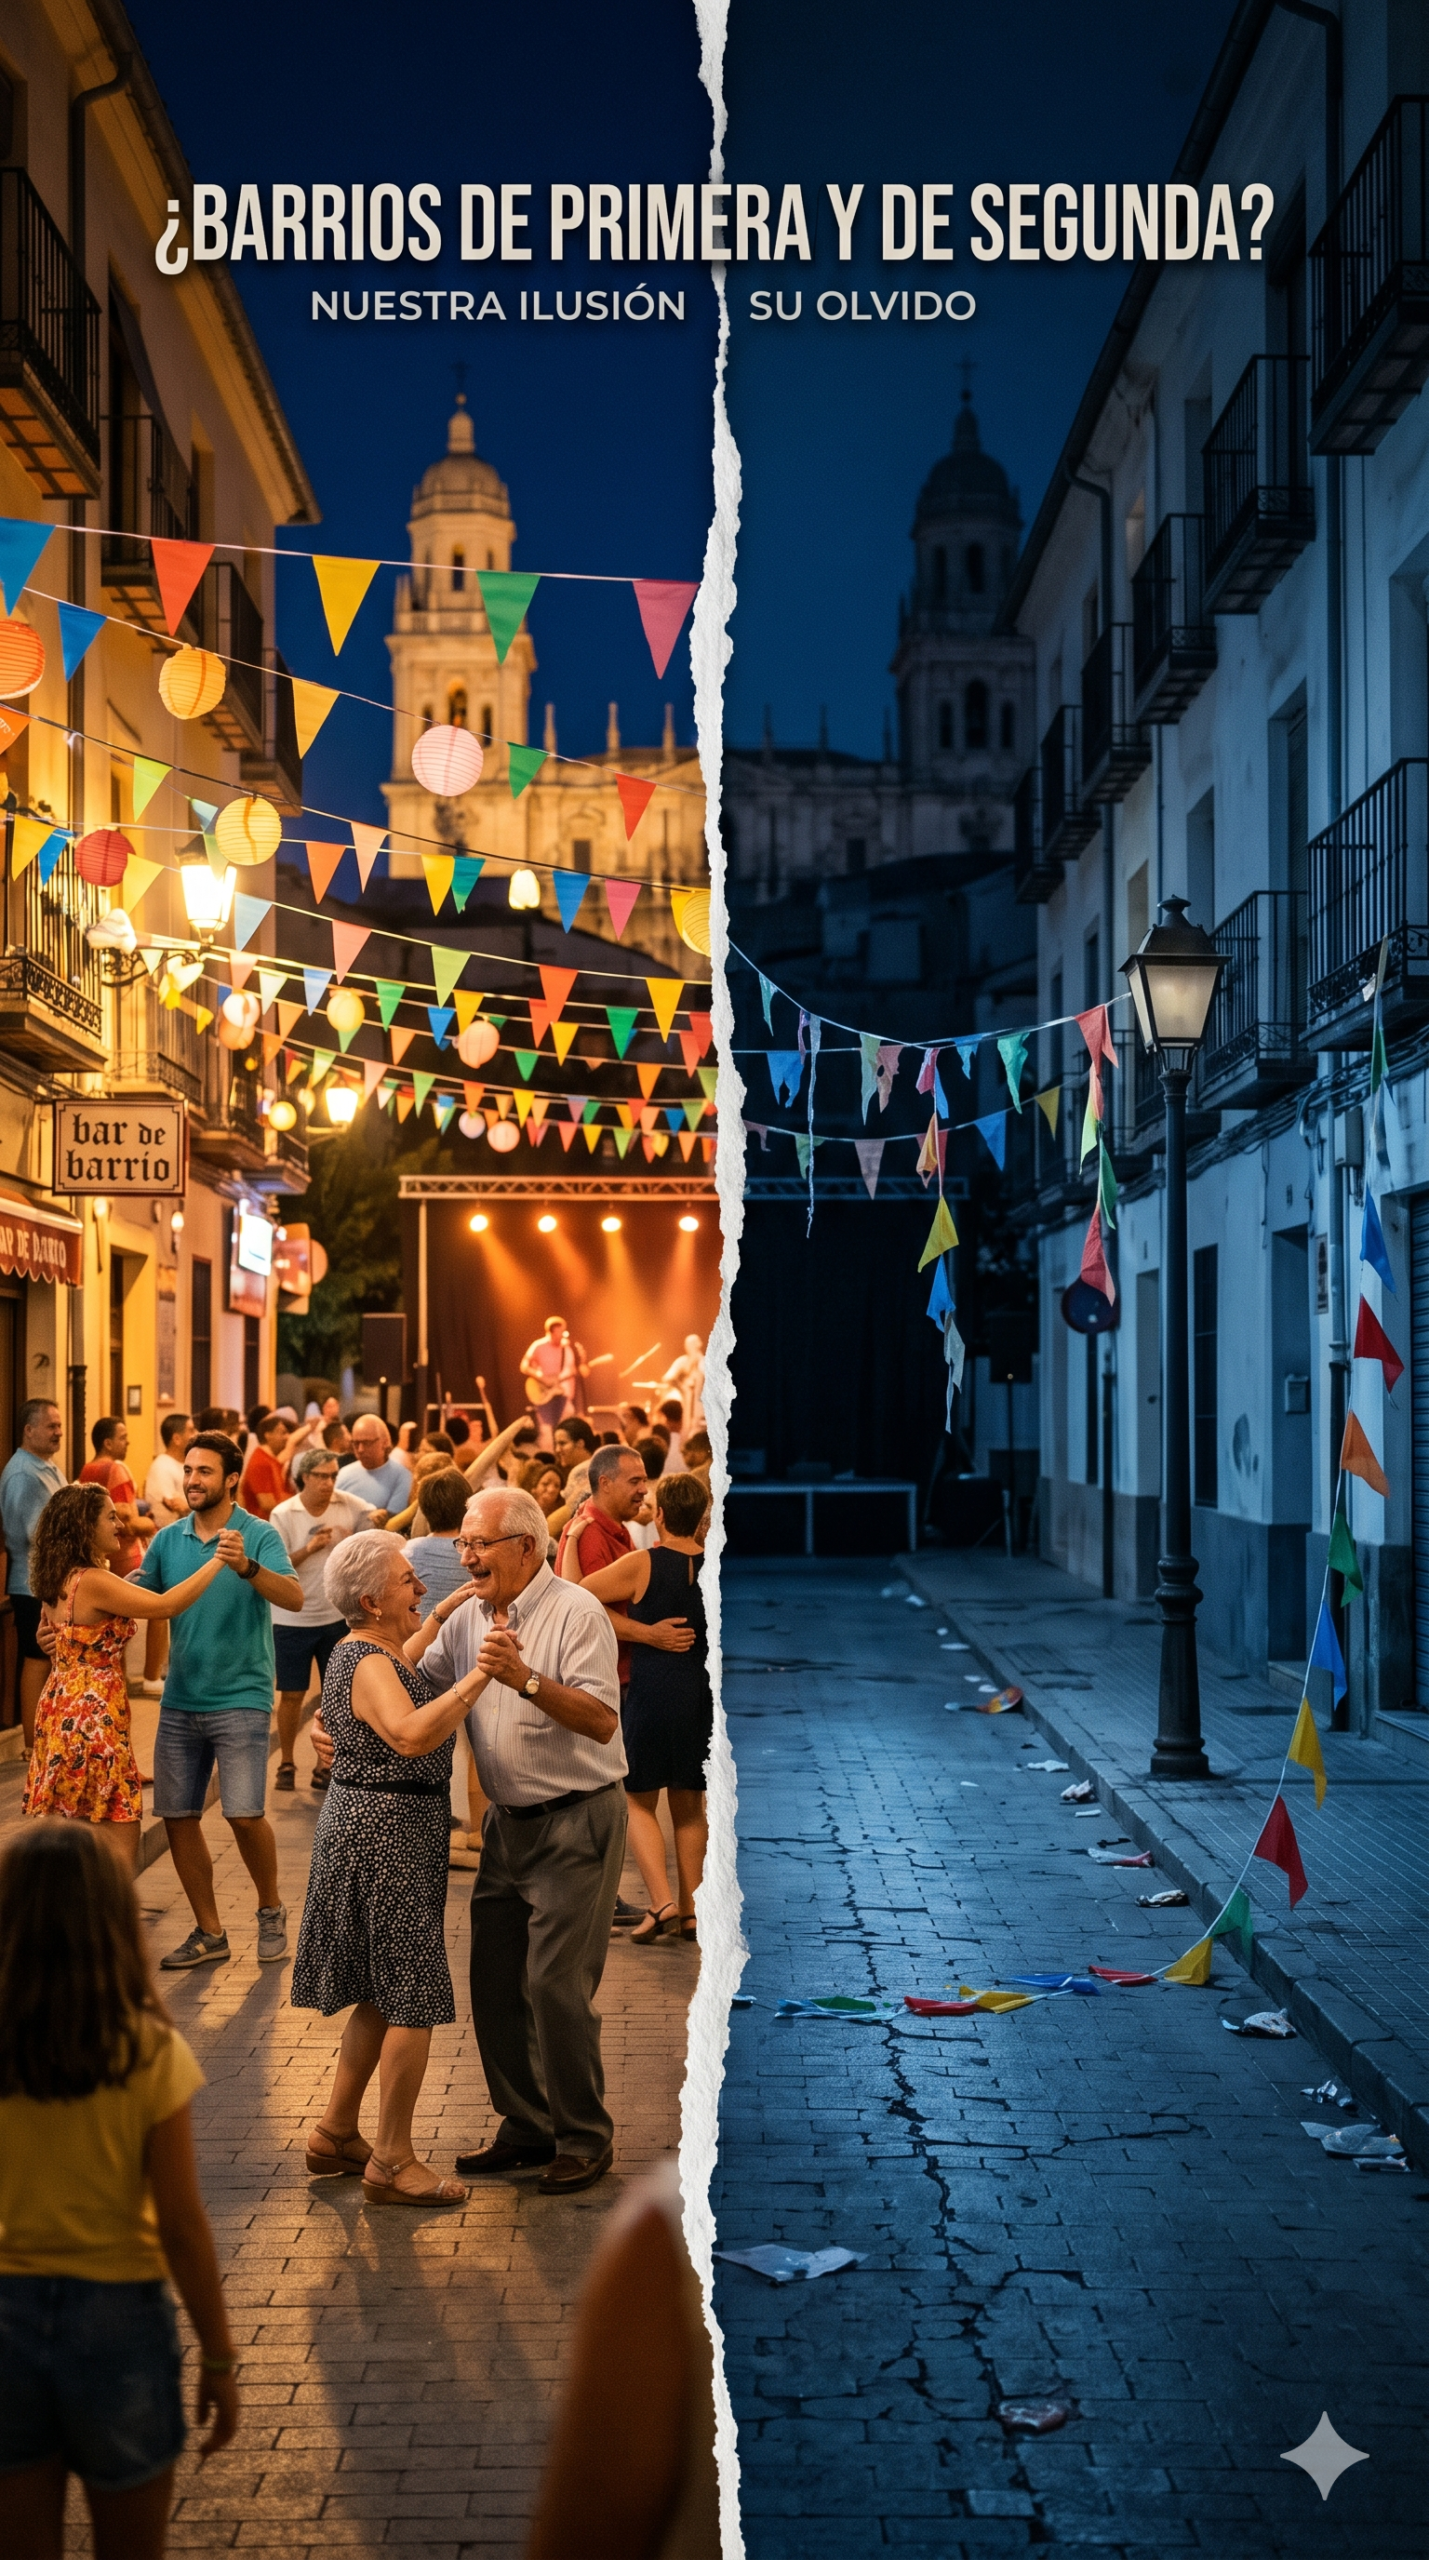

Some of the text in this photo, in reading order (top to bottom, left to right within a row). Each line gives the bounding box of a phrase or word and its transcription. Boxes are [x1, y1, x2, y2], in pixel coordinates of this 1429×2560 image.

[72, 1113, 166, 1146] bar de
[66, 1149, 170, 1182] barrio
[16, 1228, 30, 1260] DE
